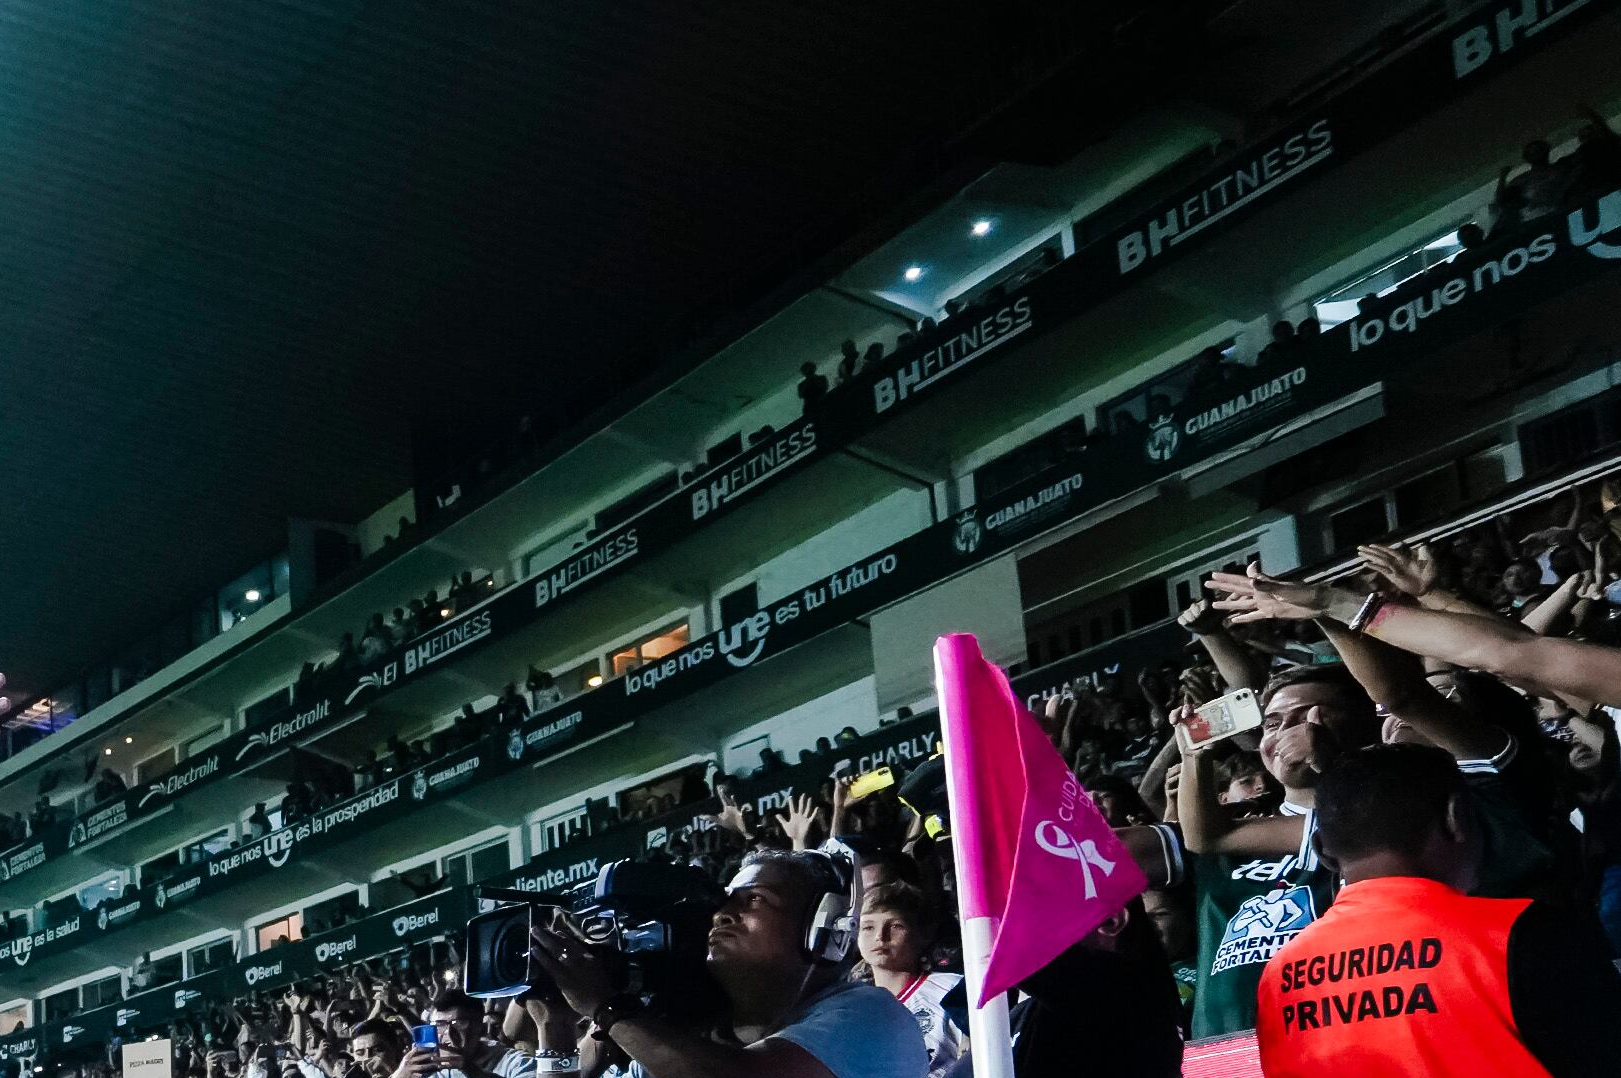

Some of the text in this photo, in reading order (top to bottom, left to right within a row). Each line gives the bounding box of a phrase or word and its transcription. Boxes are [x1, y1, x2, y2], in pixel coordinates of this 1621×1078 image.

[1349, 233, 1556, 352] lo que nos
[1185, 367, 1306, 435] GUANAJUATO
[986, 474, 1083, 531] GUANAJUATO
[625, 553, 898, 697] lo que nos une es tu futuro
[269, 699, 331, 746] Electrolit
[167, 755, 219, 795] Electrolit
[859, 730, 937, 776] CHARLY
[220, 855, 240, 875] que
[240, 845, 262, 865] nos
[263, 828, 294, 857] une
[296, 824, 310, 843] es
[312, 816, 323, 834] la
[324, 780, 399, 833] prosperidad
[34, 935, 45, 948] es
[46, 928, 54, 942] la
[55, 917, 80, 939] salud
[408, 907, 439, 930] Berel
[330, 934, 357, 955] Berel
[1212, 947, 1280, 975] FORTAL
[1281, 937, 1443, 993] SEGURIDAD
[258, 960, 282, 980] Berel
[1283, 983, 1438, 1035] PRIVADA
[9, 1039, 36, 1054] CHARLY
